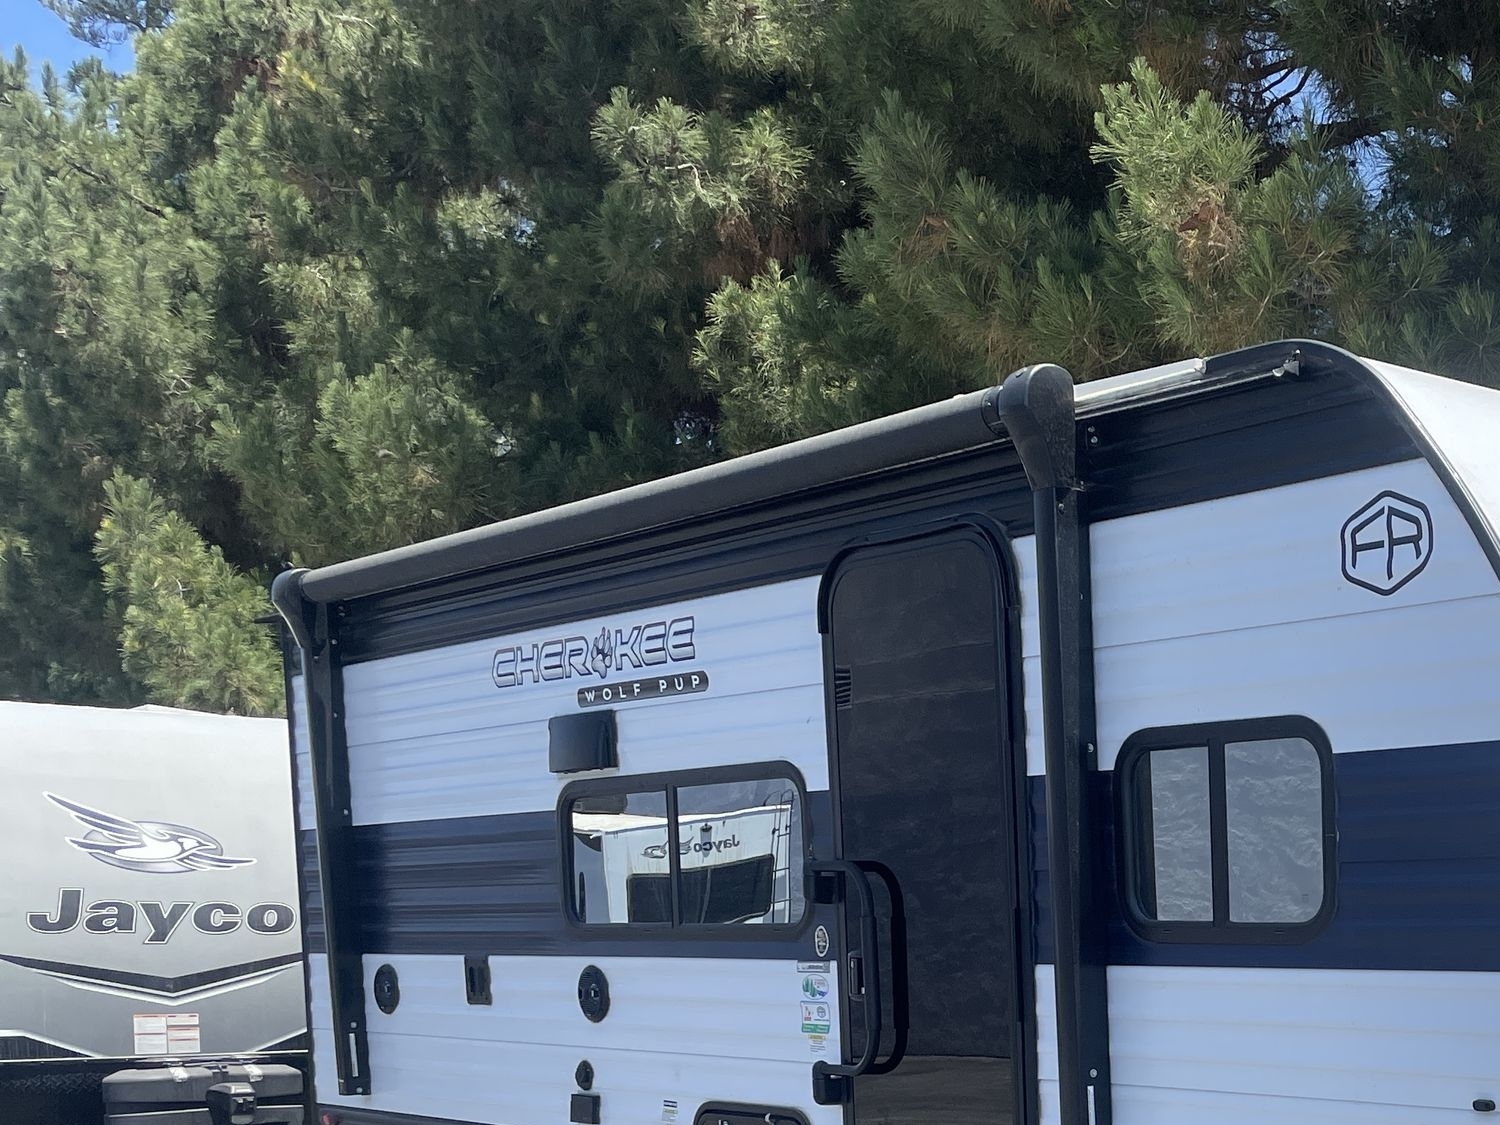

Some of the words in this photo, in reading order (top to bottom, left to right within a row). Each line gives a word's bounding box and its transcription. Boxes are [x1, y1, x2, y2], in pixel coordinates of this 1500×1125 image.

[492, 616, 695, 688] CHEROKEE
[585, 682, 641, 703] WOLF
[659, 674, 701, 693] PUP
[26, 887, 297, 944] Jayco
